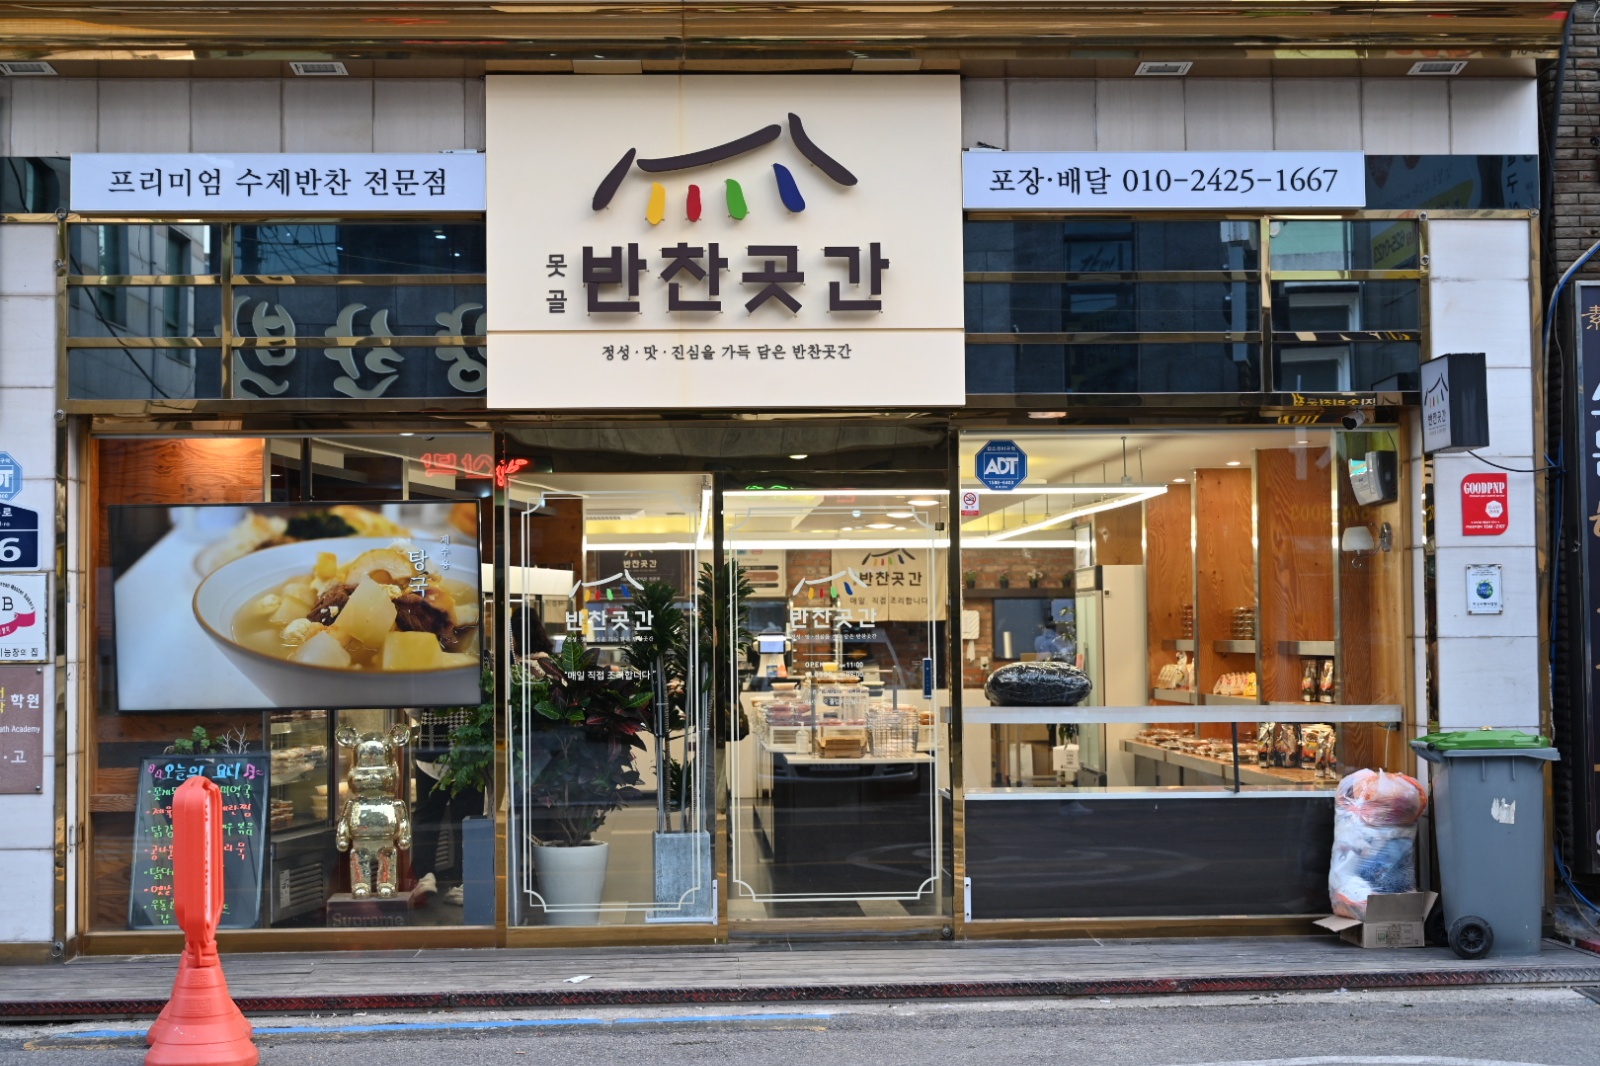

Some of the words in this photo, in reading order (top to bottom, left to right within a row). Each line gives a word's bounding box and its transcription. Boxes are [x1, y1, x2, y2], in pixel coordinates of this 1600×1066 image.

[107, 168, 222, 197] 프리미엄
[235, 168, 351, 197] 수제반찬
[363, 168, 447, 197] 전문점
[989, 167, 1112, 196] 포장·배달
[1122, 168, 1339, 194] 010-2425-1667
[545, 253, 568, 314] 못골
[582, 242, 890, 314] 반찬곳간
[721, 344, 751, 361] 가득
[757, 344, 786, 361] 담은
[792, 344, 852, 361] 반찬곳간
[984, 457, 1018, 474] ADT
[1463, 482, 1505, 494] GOODPNP
[408, 548, 430, 598] 탕국
[860, 571, 922, 587] 반찬곳간
[565, 610, 655, 631] 반찬곳간
[790, 608, 877, 629] 반찬곳간
[588, 670, 605, 681] 직접
[11, 694, 40, 709] 학원
[11, 725, 41, 734] Academy
[164, 763, 204, 781] 오늘의
[332, 913, 404, 927] Supreme
